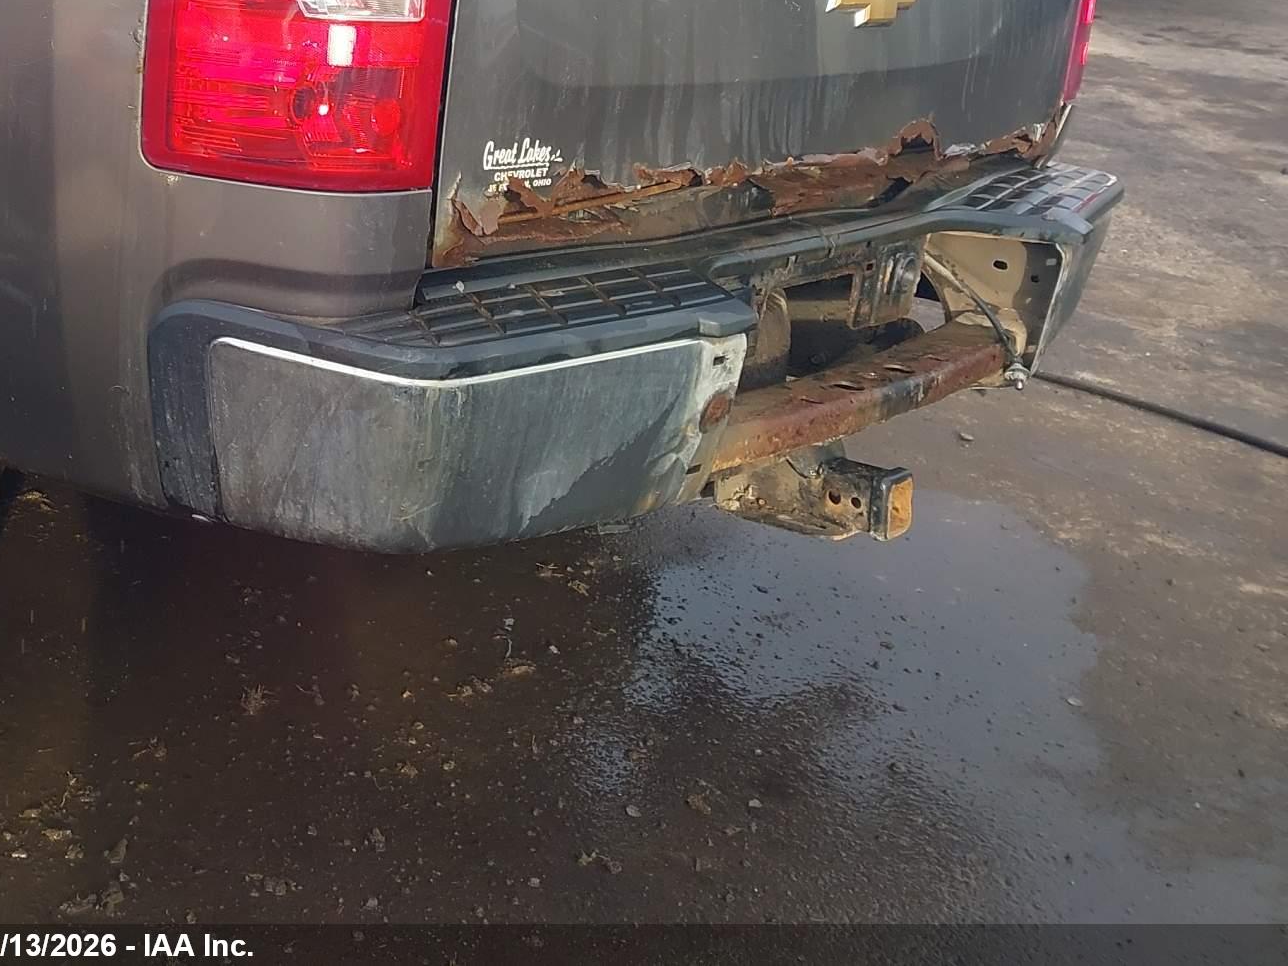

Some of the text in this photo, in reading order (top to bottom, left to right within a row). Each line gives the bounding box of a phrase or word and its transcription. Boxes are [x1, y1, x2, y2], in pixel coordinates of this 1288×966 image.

[483, 137, 552, 170] Great Lakes
[532, 178, 552, 187] OHIO
